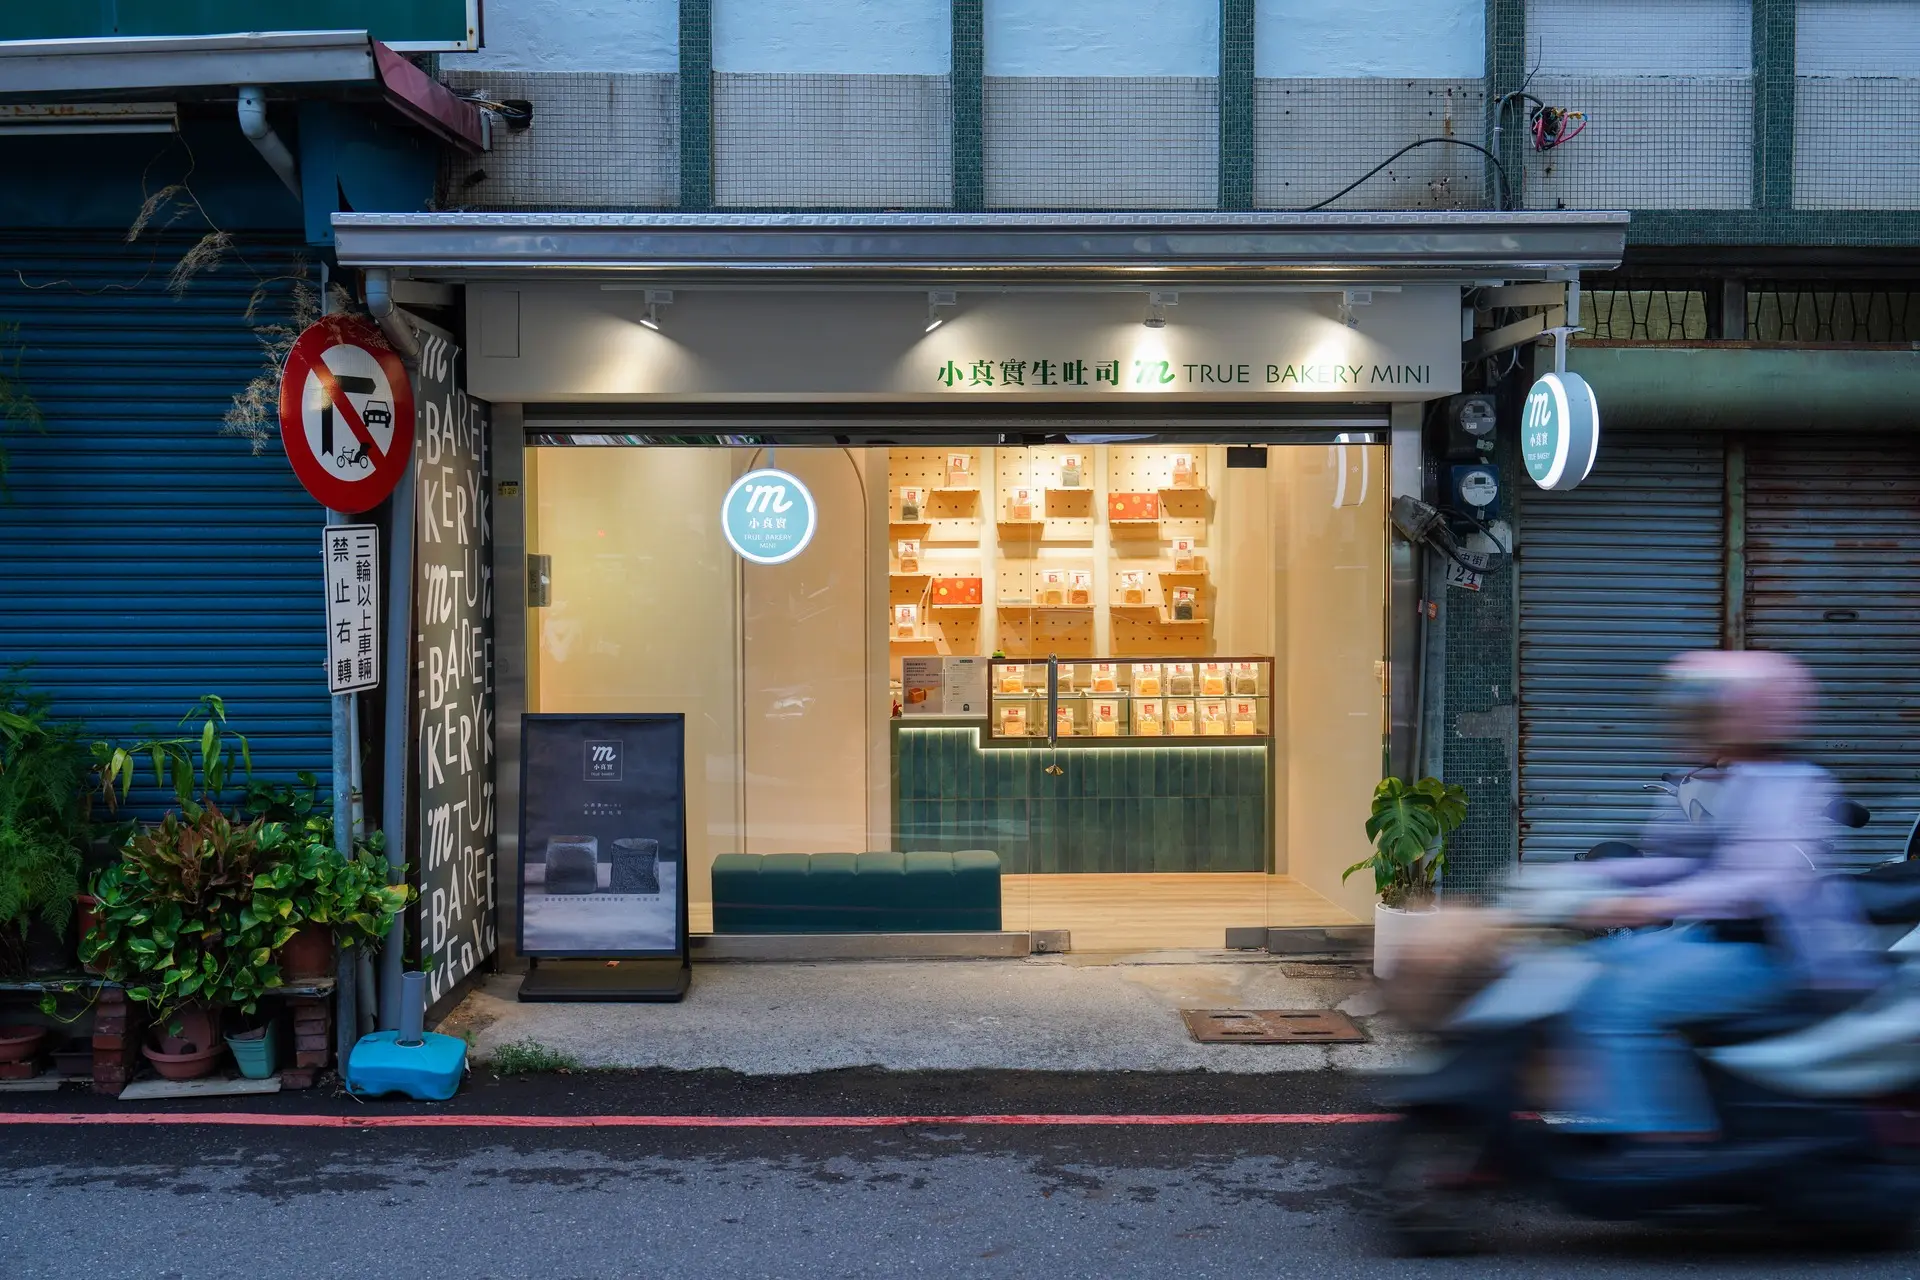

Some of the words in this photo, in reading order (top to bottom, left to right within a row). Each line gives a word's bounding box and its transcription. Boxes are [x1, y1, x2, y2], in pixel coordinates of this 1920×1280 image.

[937, 358, 1120, 387] 小真實生吐司
[1183, 364, 1250, 383] TRUE
[1266, 364, 1364, 383] BAKERY
[1370, 364, 1431, 383] MINI
[332, 536, 353, 684] 禁止右轉
[355, 535, 373, 681] 三輪以上車輛
